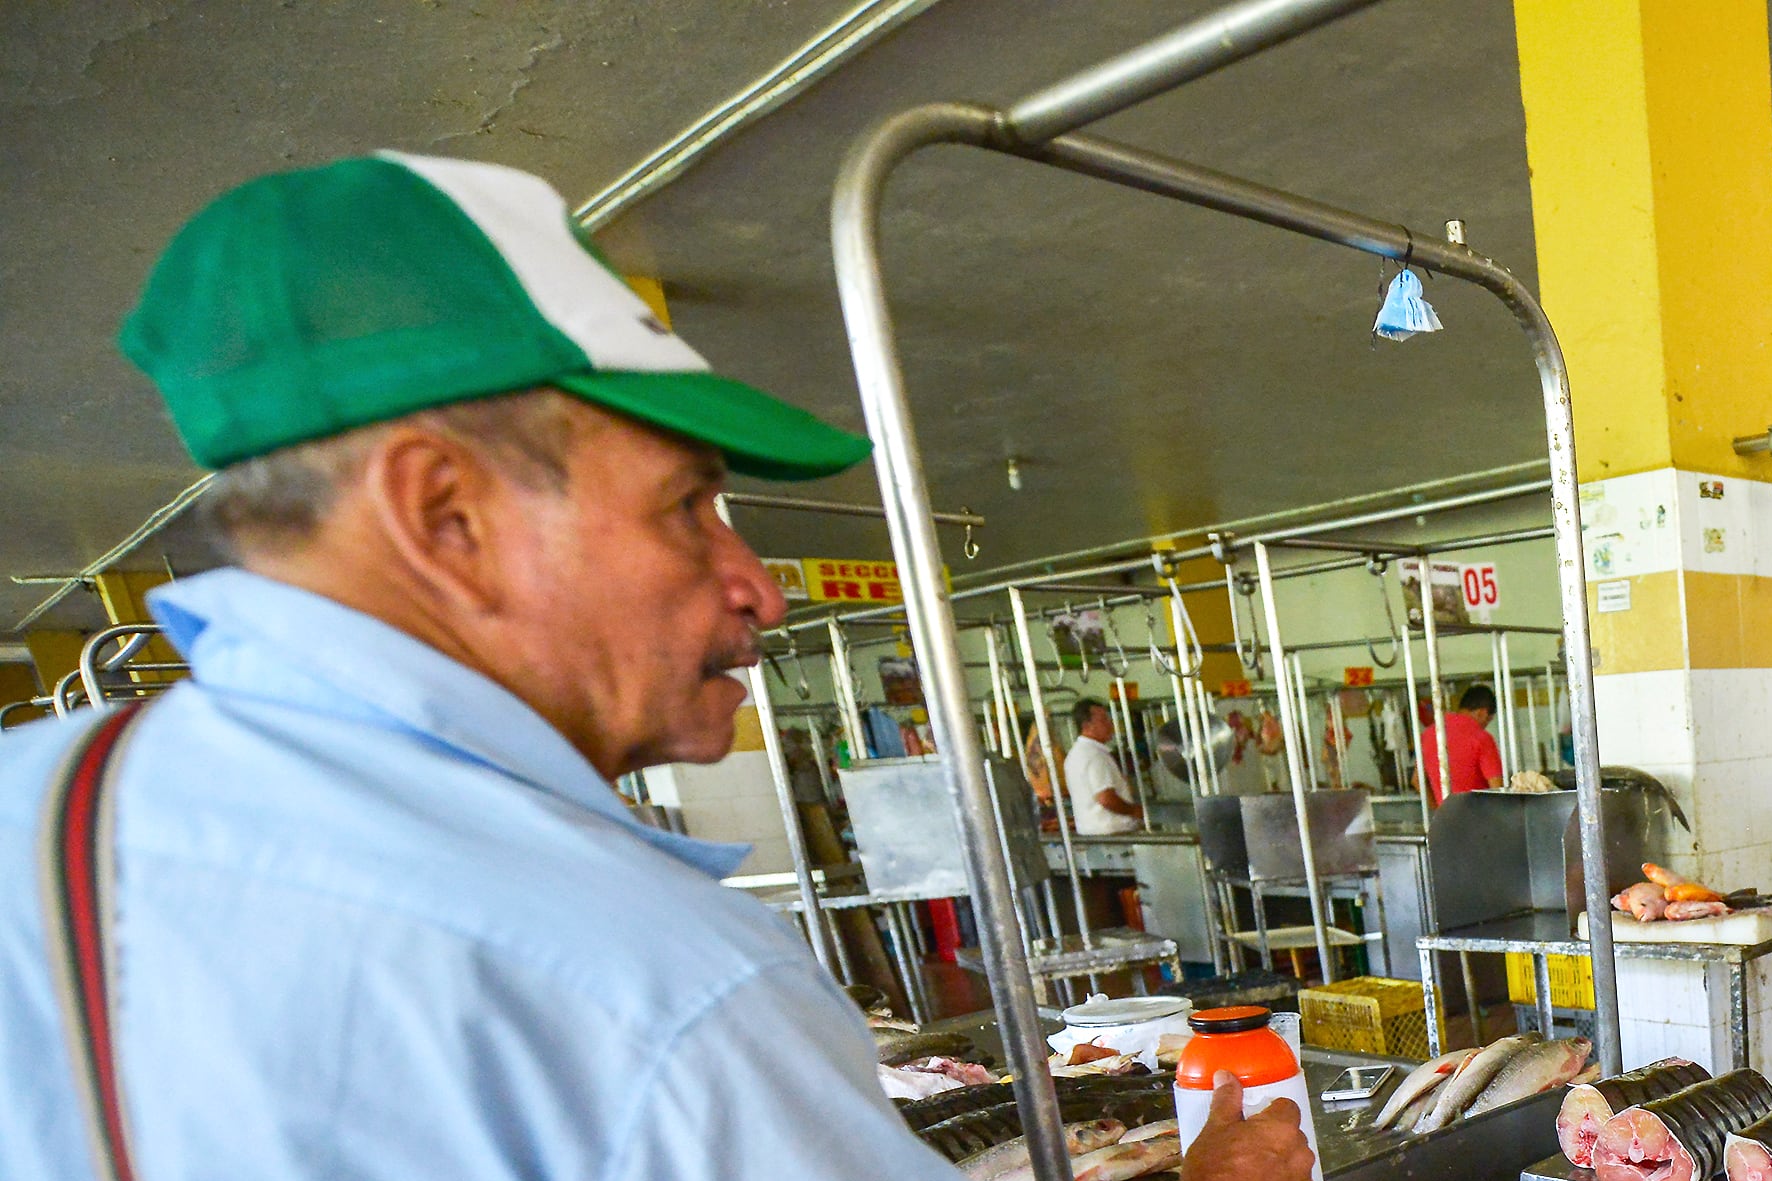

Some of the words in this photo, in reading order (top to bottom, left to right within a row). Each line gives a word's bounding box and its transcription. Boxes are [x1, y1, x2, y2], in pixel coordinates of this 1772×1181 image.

[819, 562, 898, 578] SECCI
[821, 580, 904, 599] RE
[1463, 566, 1498, 606] 05
